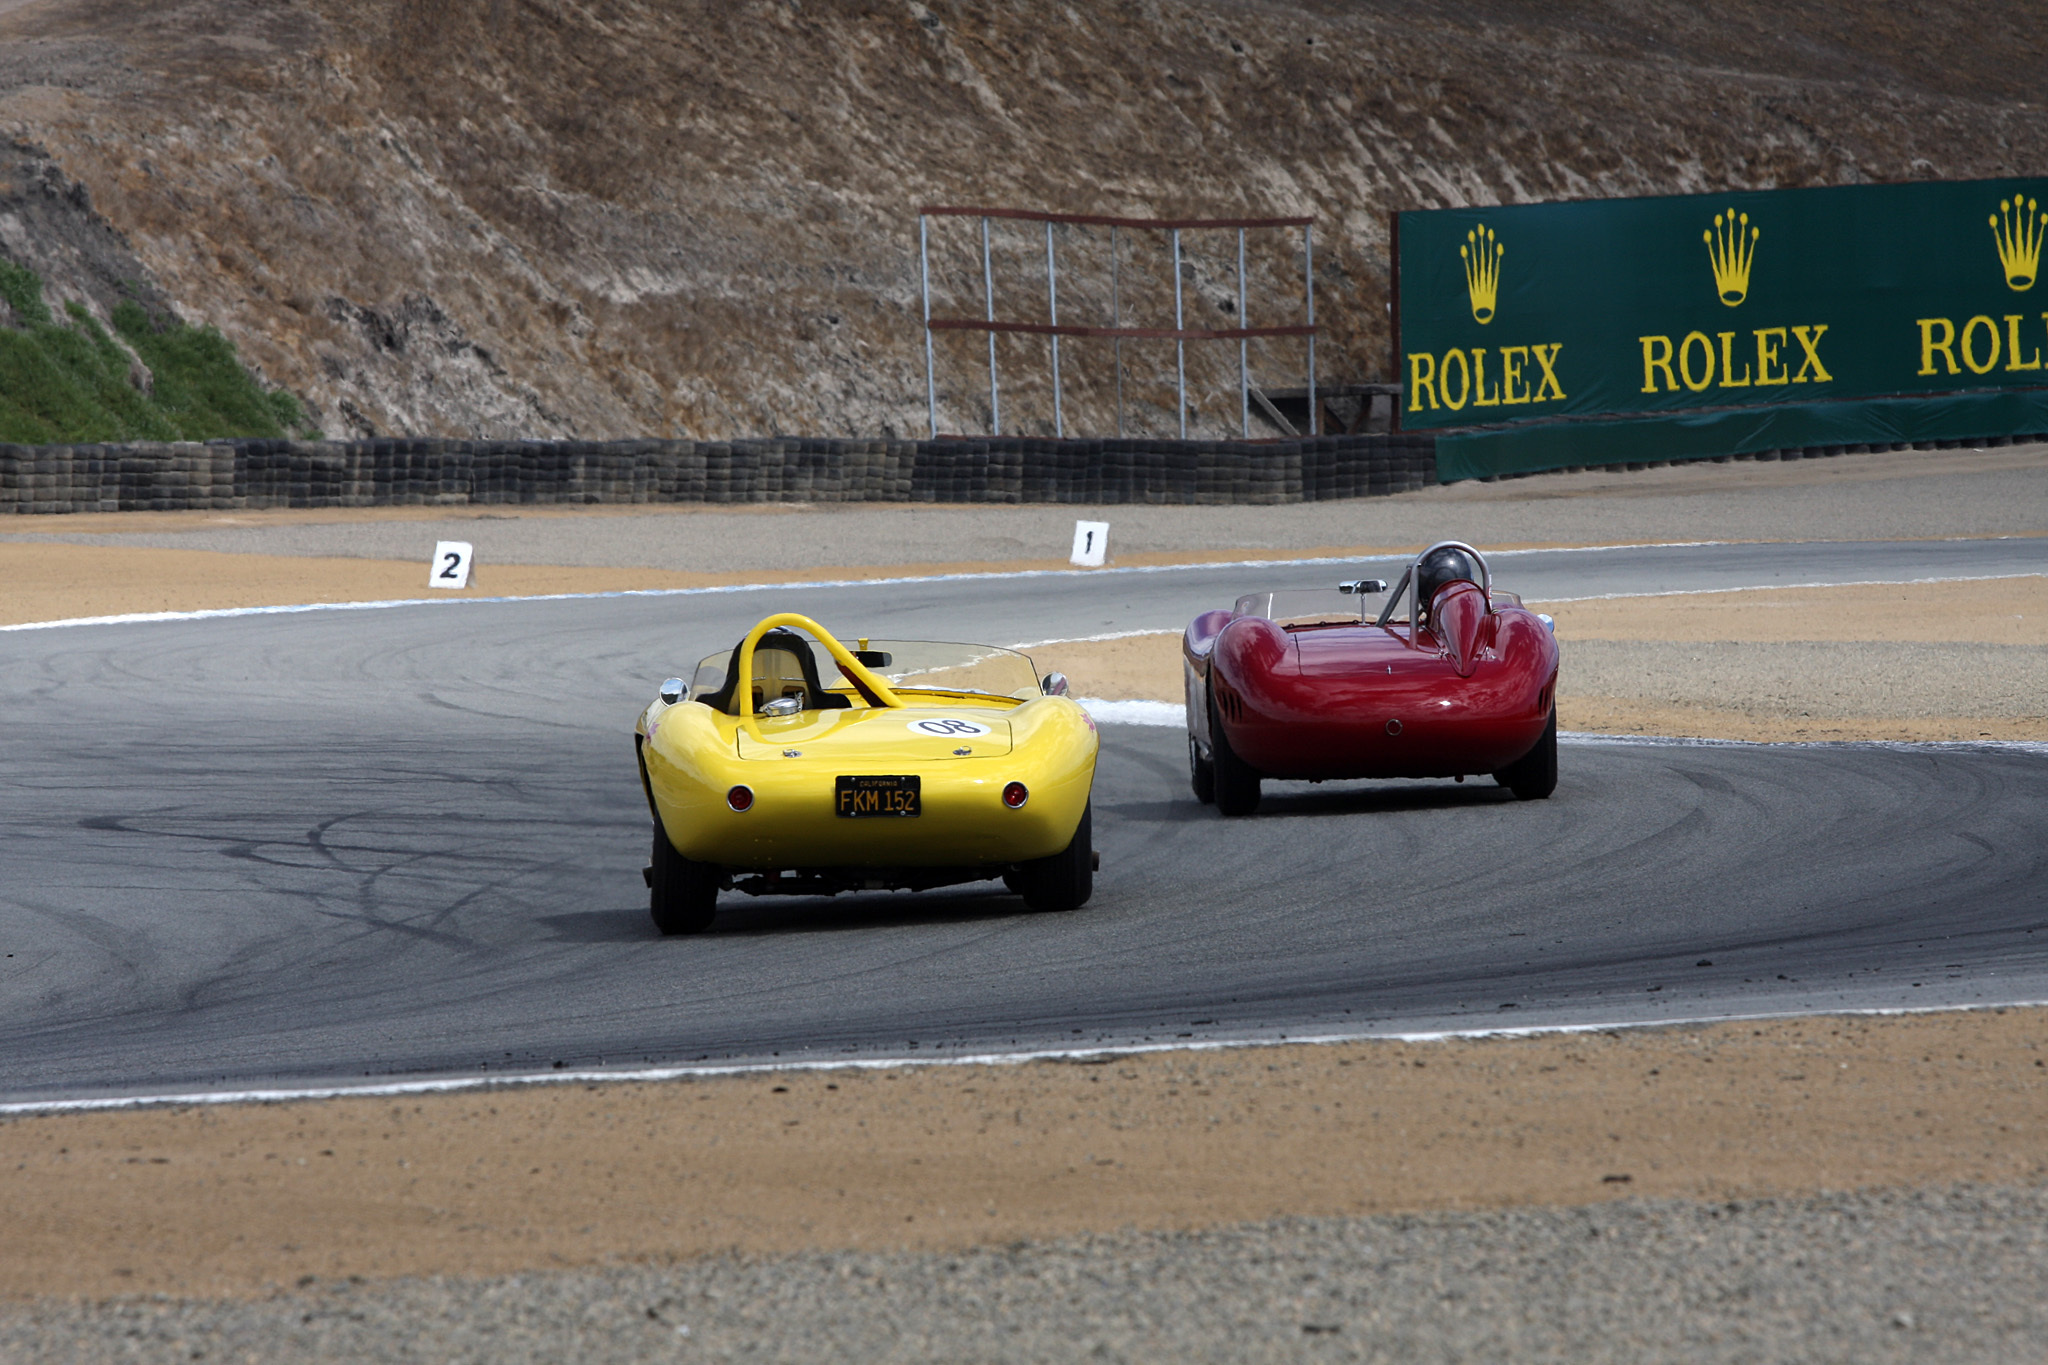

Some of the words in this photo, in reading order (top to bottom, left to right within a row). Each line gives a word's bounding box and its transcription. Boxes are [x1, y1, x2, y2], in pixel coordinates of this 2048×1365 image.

[1916, 312, 2048, 376] ROL
[1639, 324, 1833, 393] ROLEX
[1407, 343, 1567, 412] ROLEX
[1085, 530, 1093, 555] 1
[439, 552, 461, 579] 2
[918, 719, 981, 735] 08
[841, 790, 879, 811] FKM
[884, 790, 915, 811] 152
